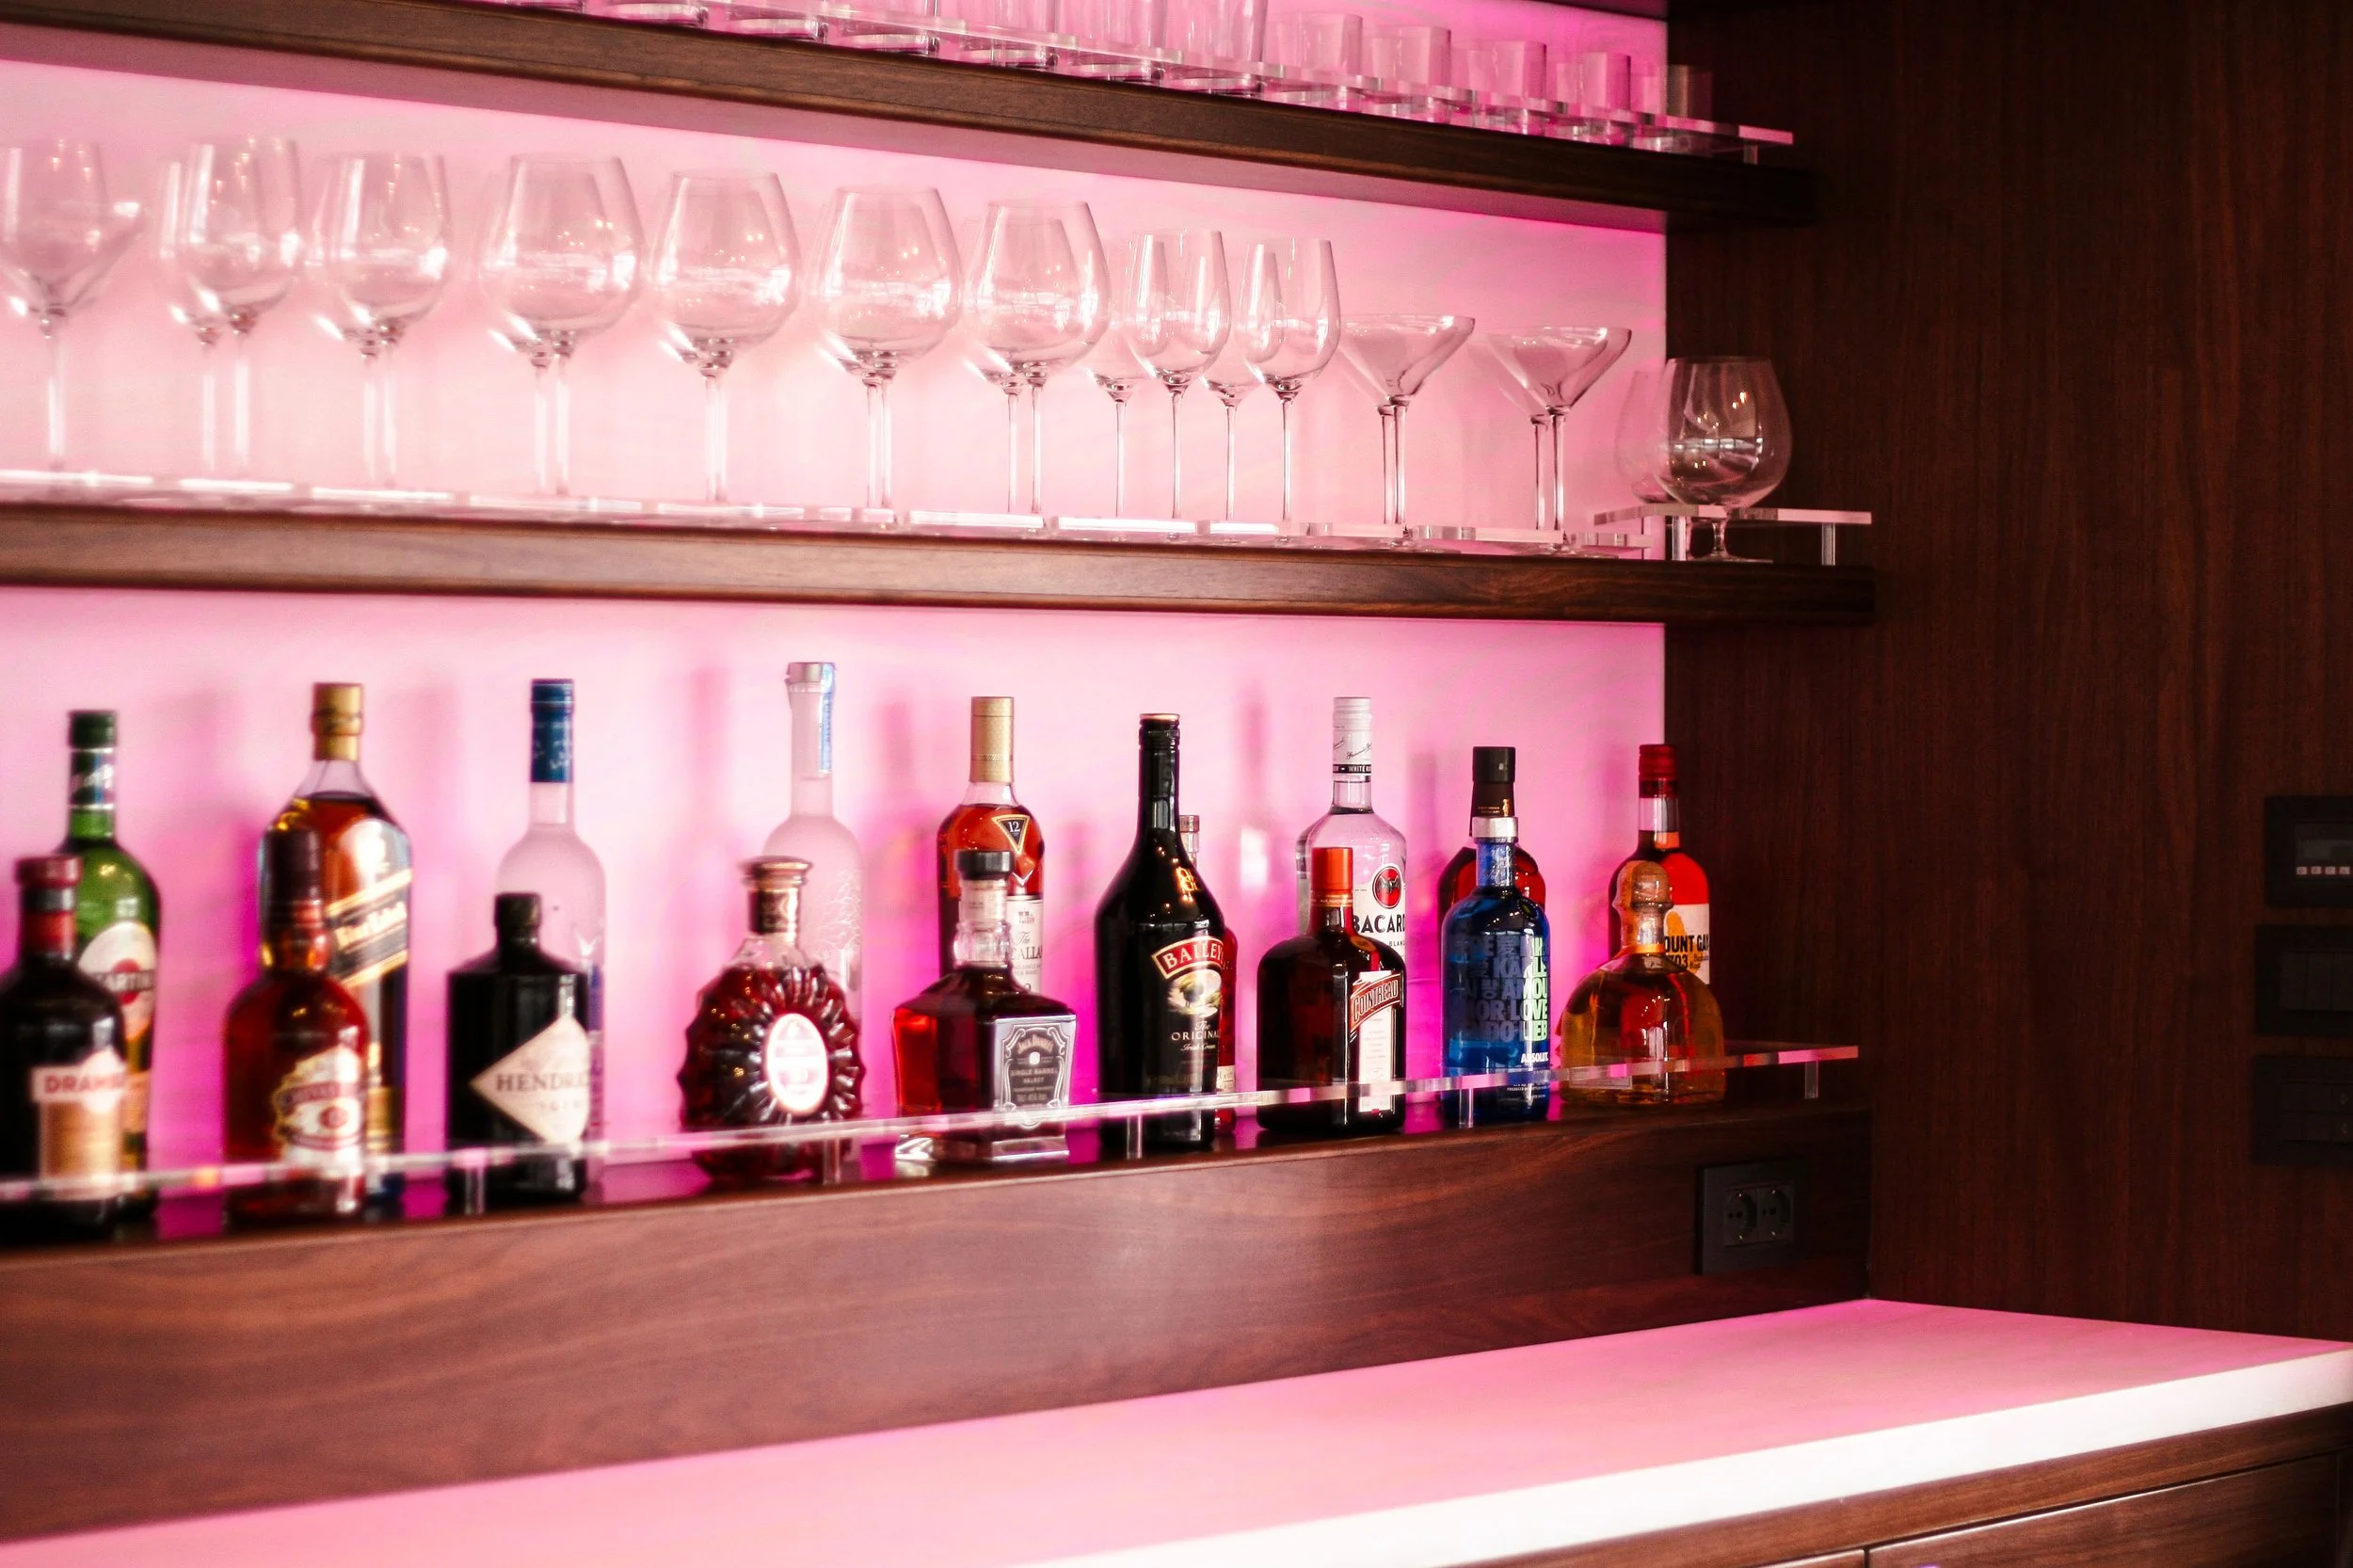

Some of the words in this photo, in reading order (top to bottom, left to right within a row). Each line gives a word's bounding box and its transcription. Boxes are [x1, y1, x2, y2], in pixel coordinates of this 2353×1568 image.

[1008, 821, 1021, 833] 12
[1353, 913, 1405, 934] BACAR
[1665, 936, 1695, 952] OUNT
[1353, 979, 1400, 1022] COINTREAU
